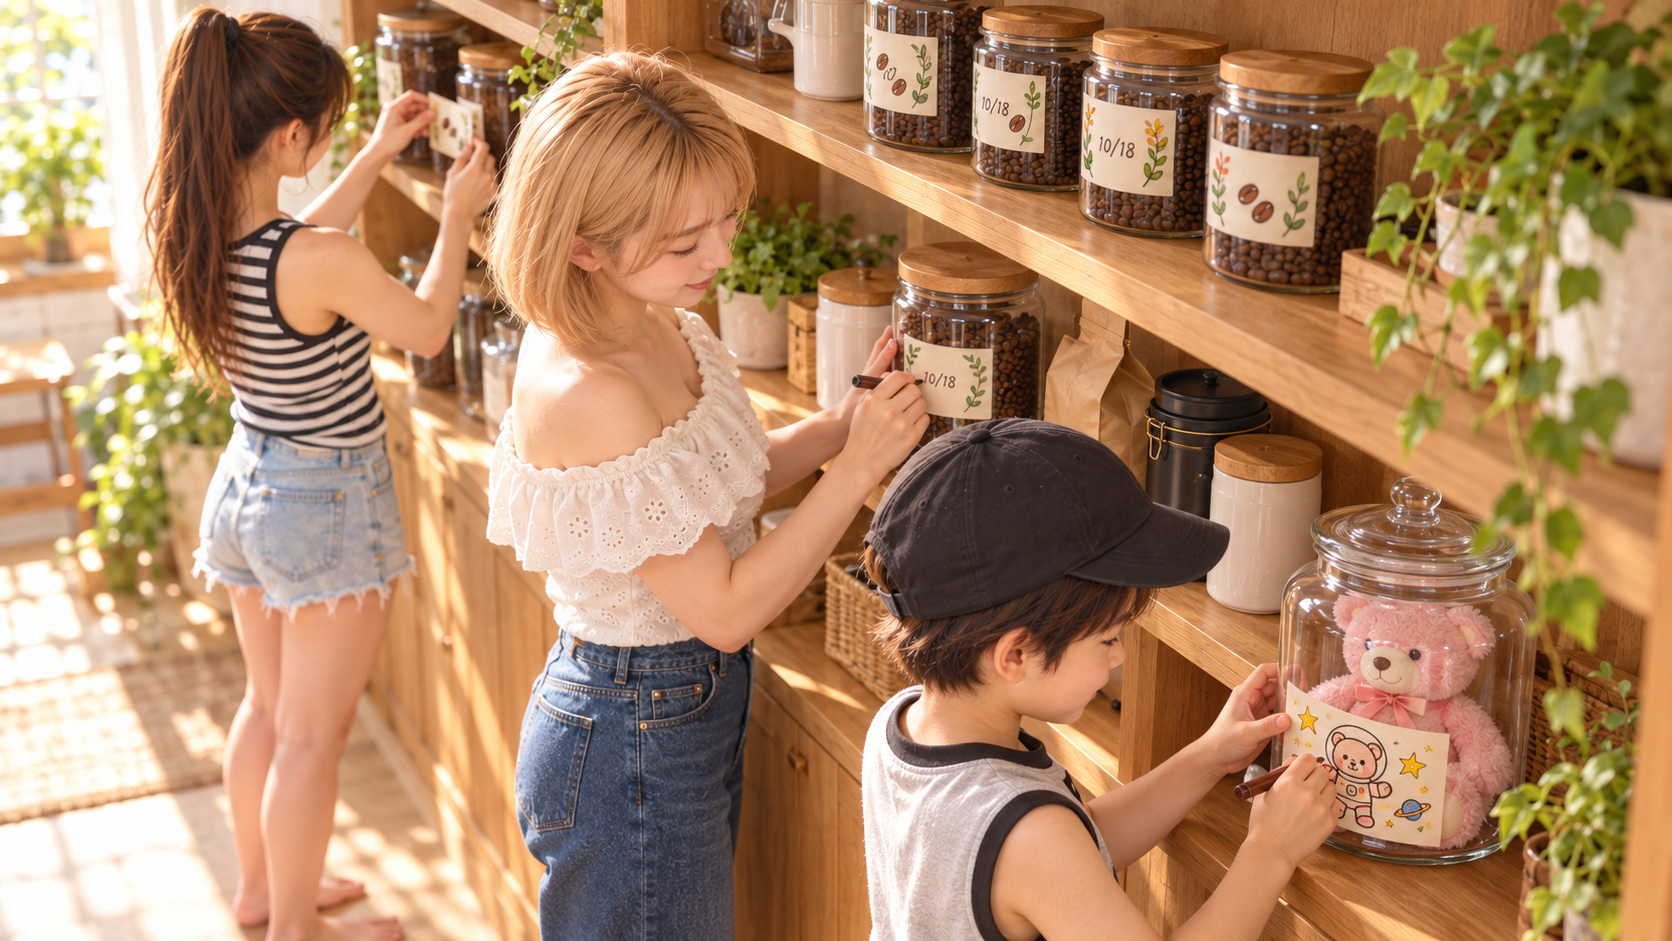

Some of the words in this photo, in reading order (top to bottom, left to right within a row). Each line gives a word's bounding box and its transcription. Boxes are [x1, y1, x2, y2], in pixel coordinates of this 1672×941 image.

[982, 96, 1010, 117] 10/18
[1099, 136, 1135, 159] 10/18
[924, 371, 956, 389] 10/18
